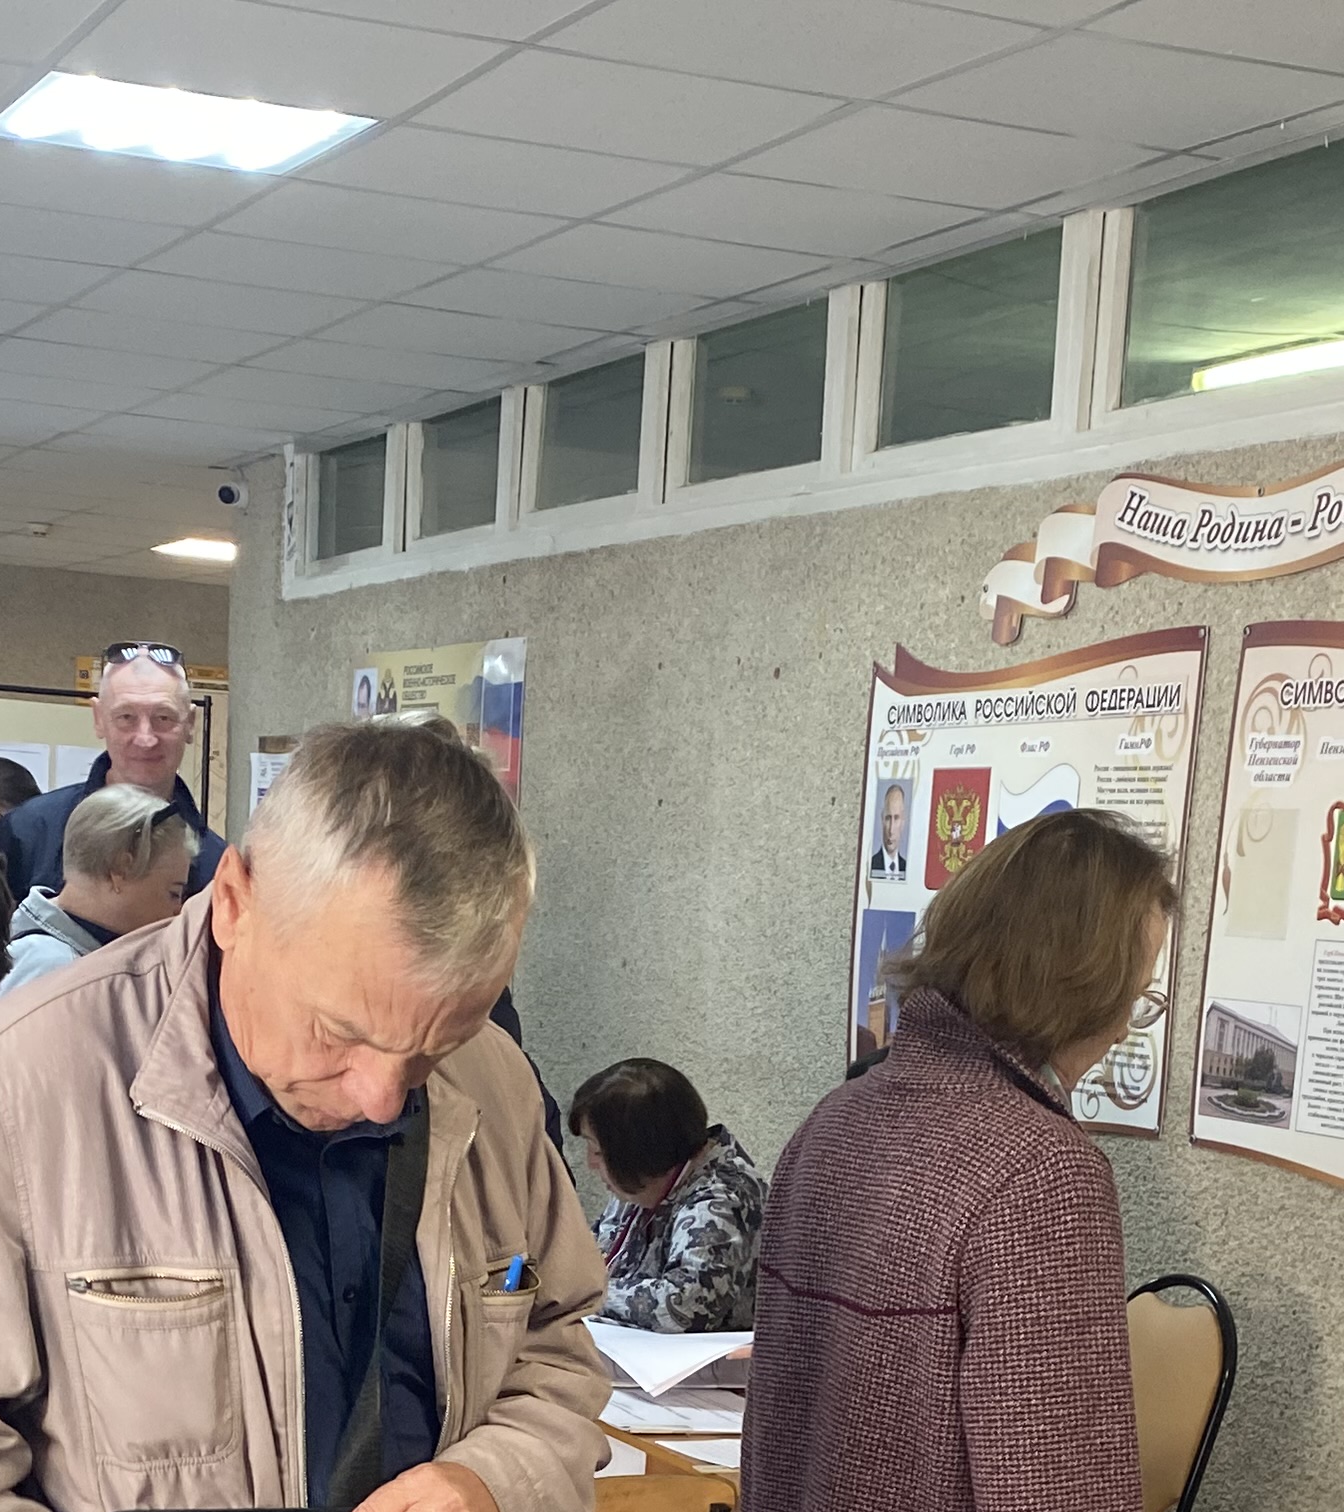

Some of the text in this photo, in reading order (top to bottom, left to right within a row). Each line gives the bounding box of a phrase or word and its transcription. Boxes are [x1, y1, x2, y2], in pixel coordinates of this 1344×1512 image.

[1118, 490, 1185, 541] Наша
[1190, 508, 1282, 544] Родина
[887, 684, 1182, 725] СИМВОЛИКА РОССИЙСКОЙ ФЕДЕРАЦИИ
[909, 745, 921, 756] РФ
[964, 744, 976, 754] РФ
[1038, 741, 1051, 752] РФ
[1249, 738, 1300, 752] Губернатор
[1247, 753, 1298, 767] Пензенской
[1253, 770, 1291, 783] области
